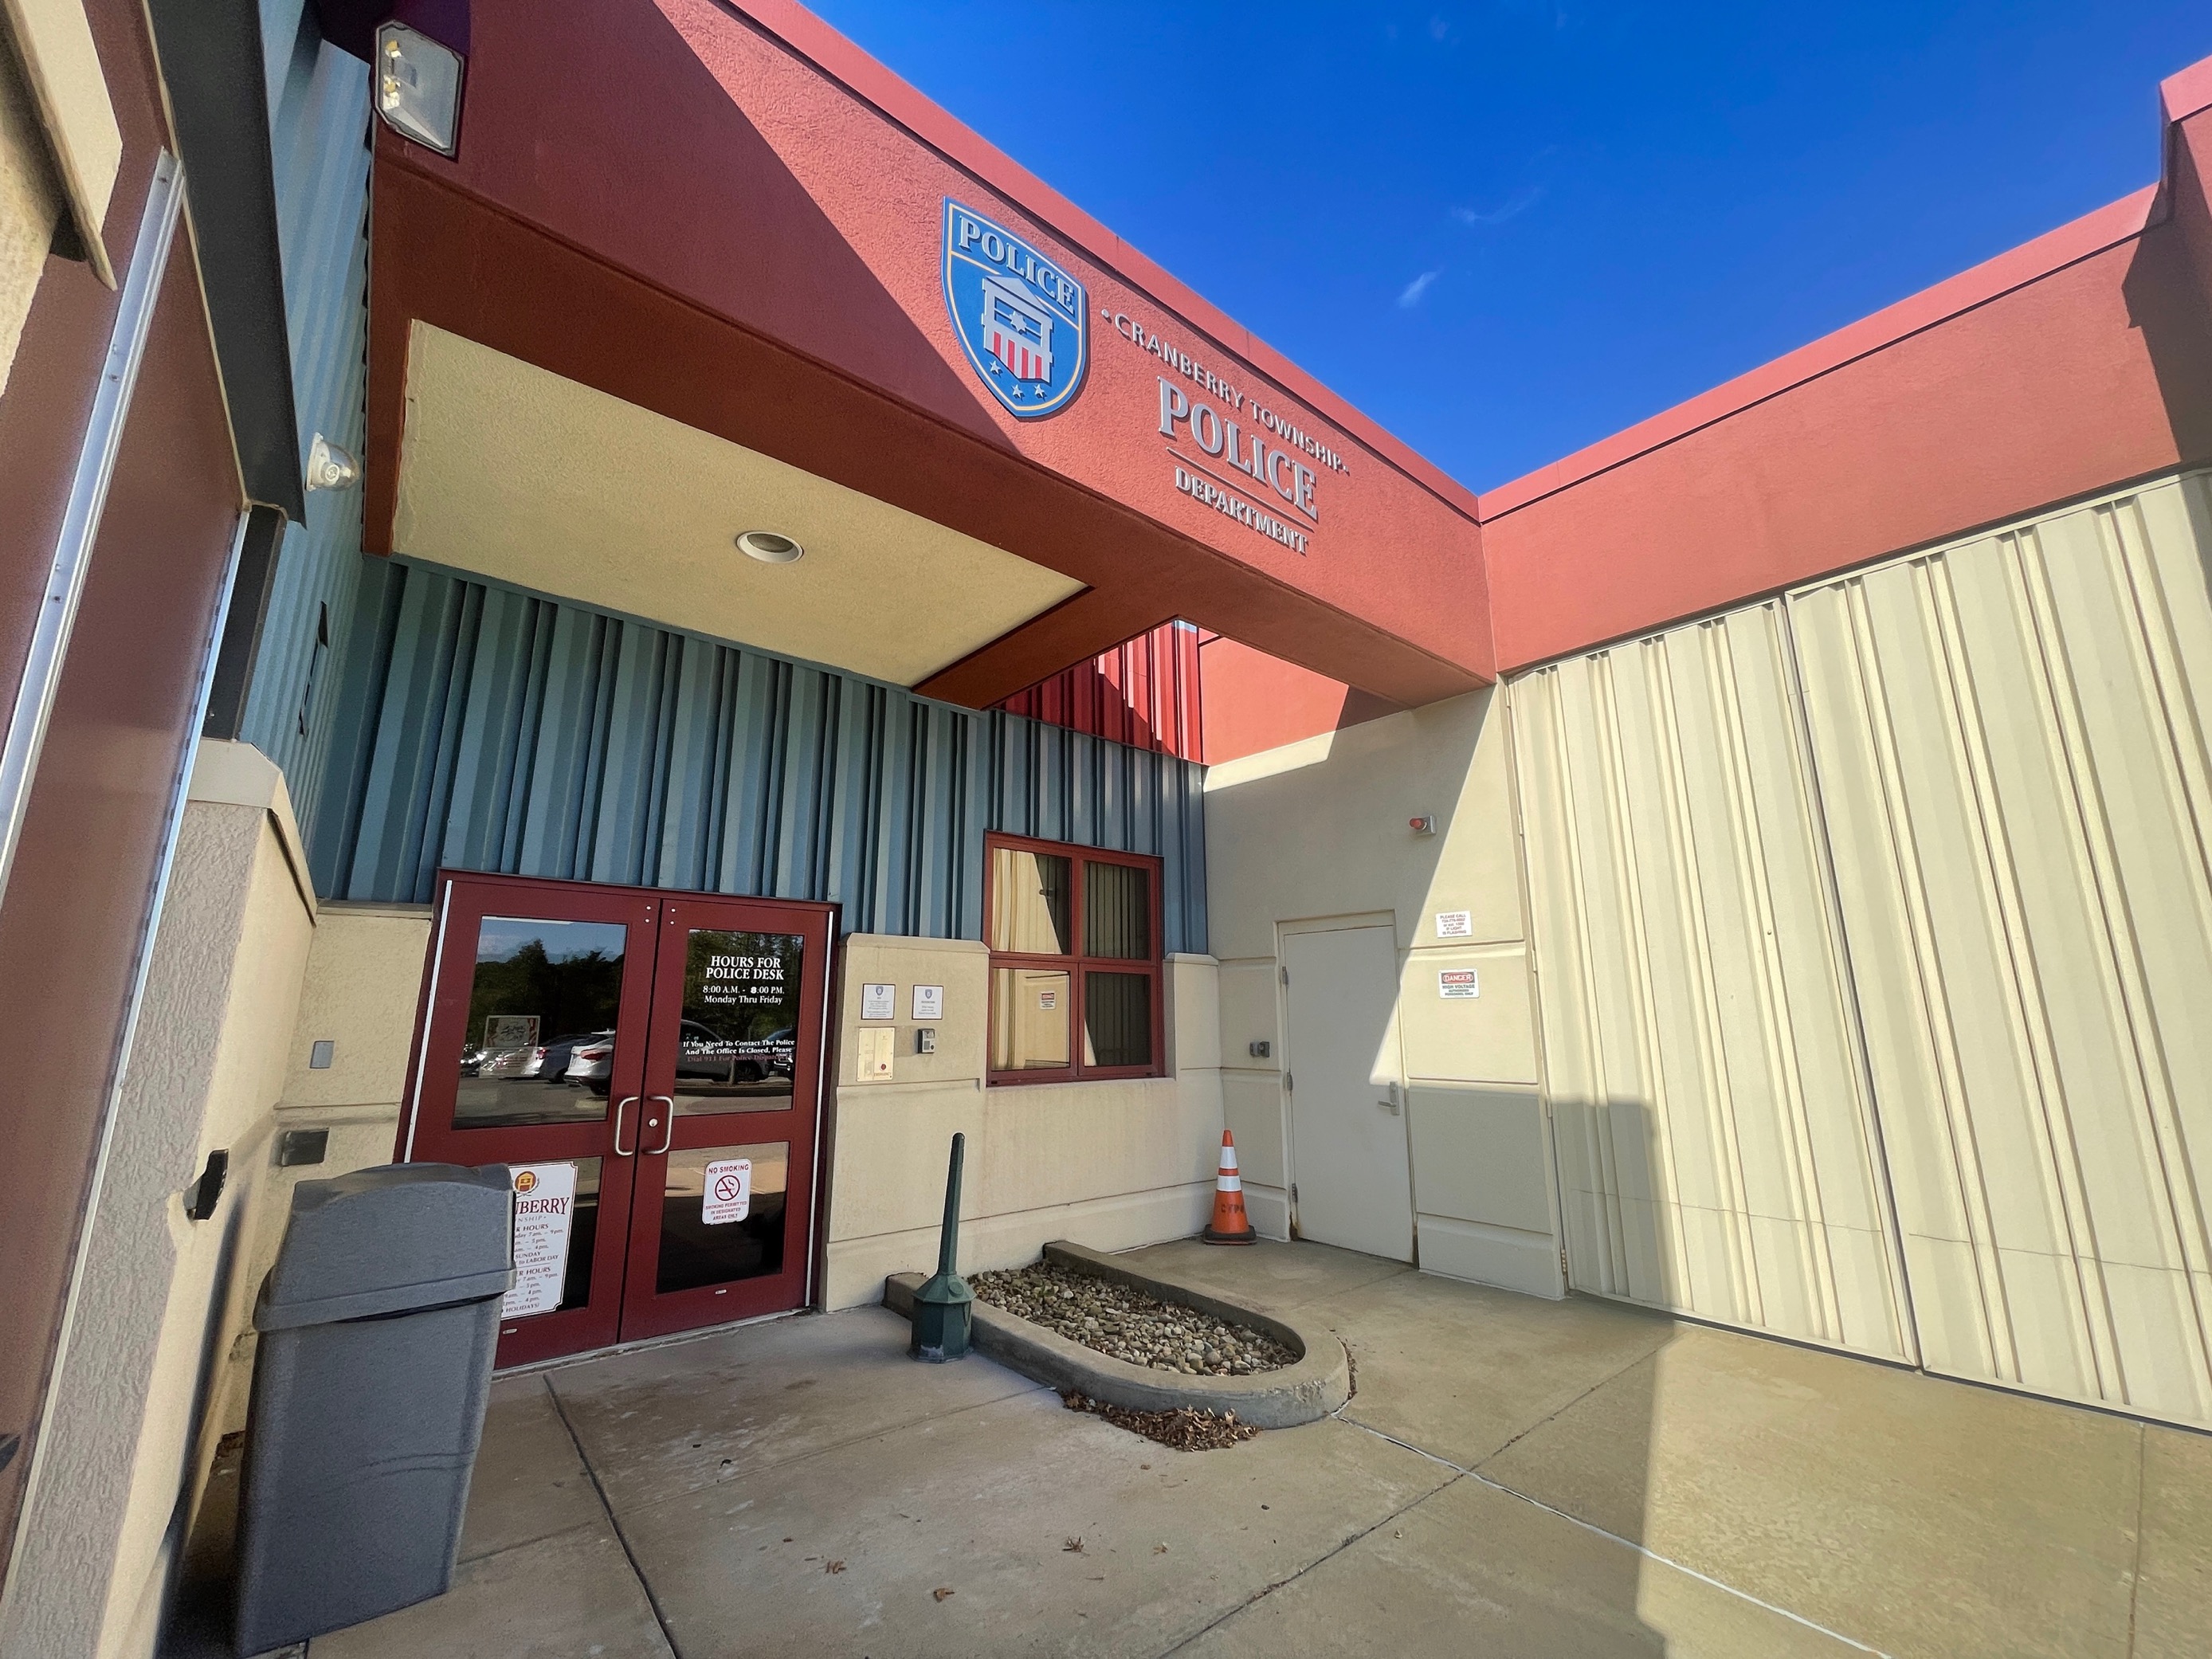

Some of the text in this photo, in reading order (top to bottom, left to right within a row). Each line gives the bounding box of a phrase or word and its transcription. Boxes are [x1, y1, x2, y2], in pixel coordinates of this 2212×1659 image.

[959, 215, 1075, 315] POLICE
[1115, 312, 1345, 473] CRANBERRY TOWNSHIP
[1157, 375, 1318, 521] POLICE
[1175, 465, 1309, 555] DEPARTMENT
[711, 955, 781, 968] HOURS FOR
[705, 967, 785, 980] POLICE DESK
[702, 985, 721, 994] 8:00
[722, 985, 740, 994] A.M.
[704, 995, 737, 1005] Monday
[759, 995, 783, 1006] Friday
[720, 1163, 749, 1173] SMOKING
[523, 1223, 549, 1232] HOURS
